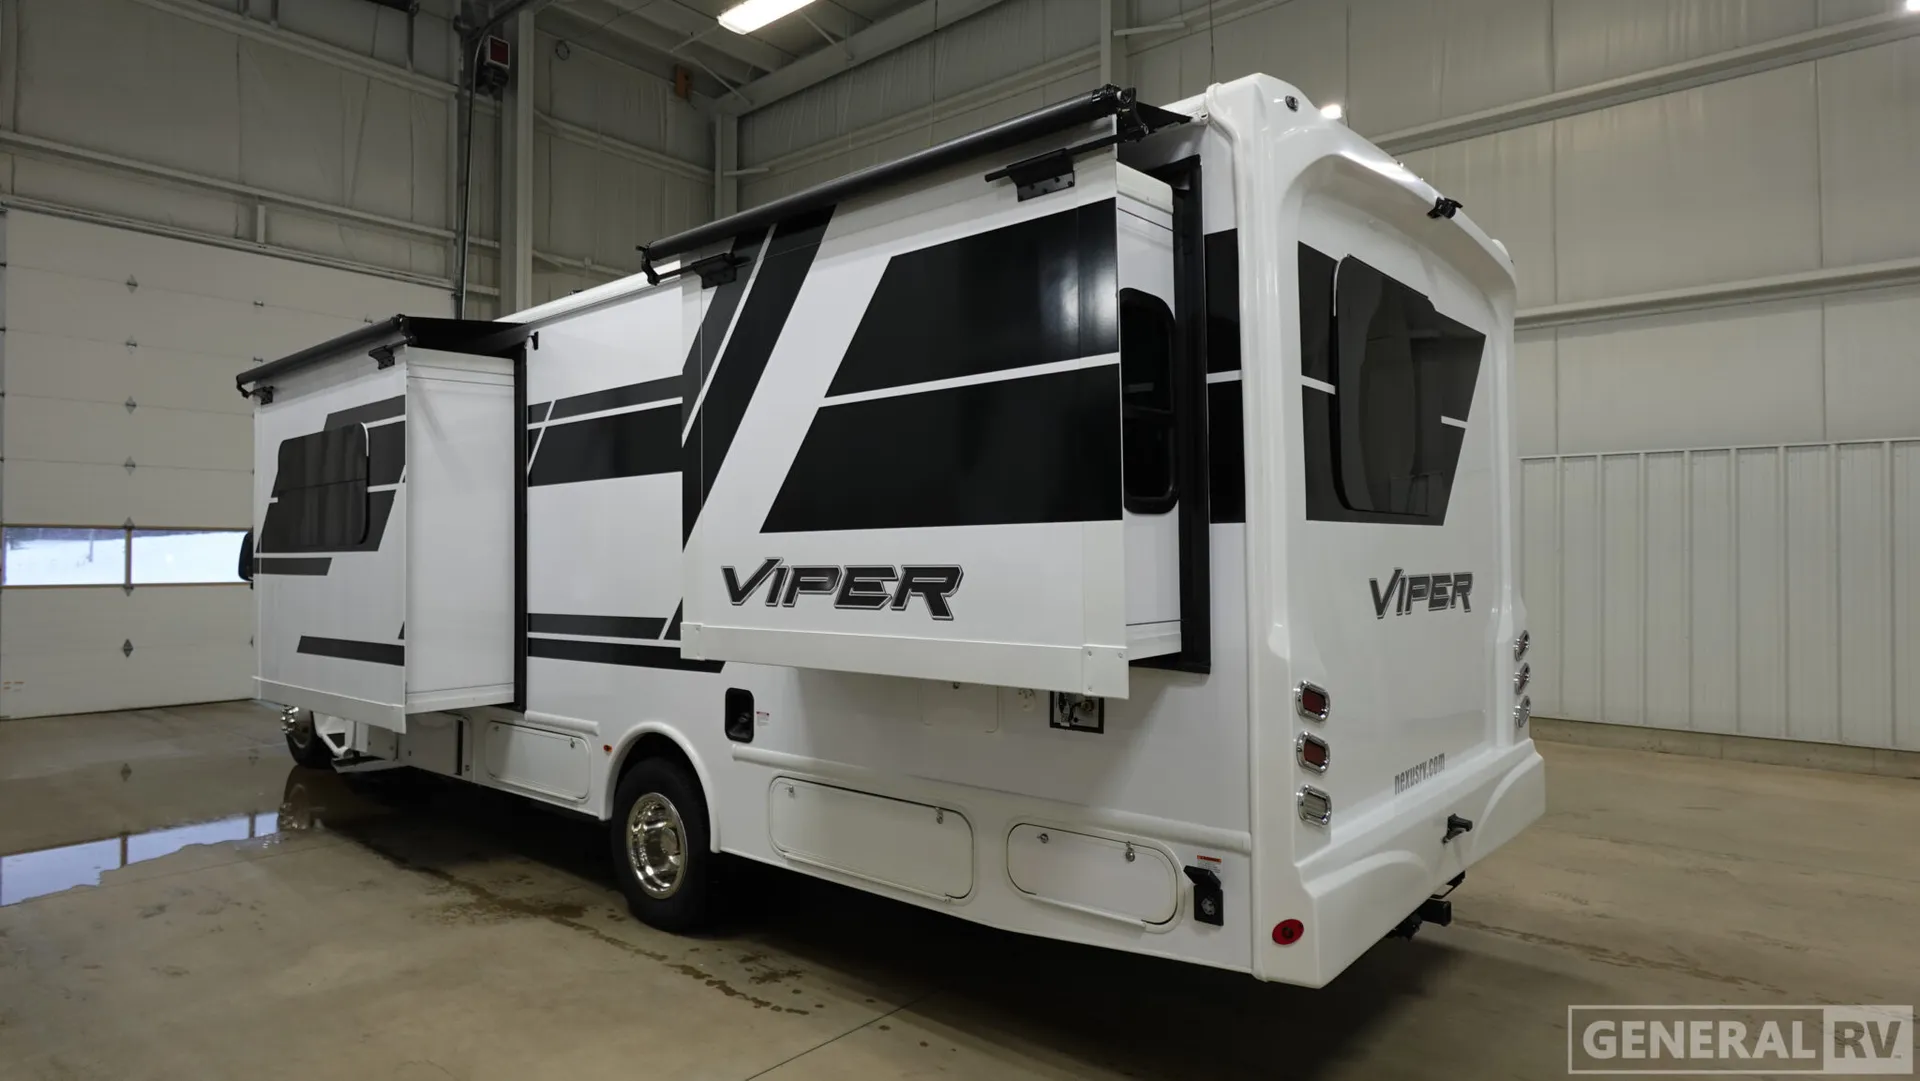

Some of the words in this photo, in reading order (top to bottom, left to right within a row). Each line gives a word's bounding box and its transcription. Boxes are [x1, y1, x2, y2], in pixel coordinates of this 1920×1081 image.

[721, 556, 964, 621] VIPER
[1369, 567, 1474, 620] VIPER
[1394, 752, 1445, 796] nexusrv.com
